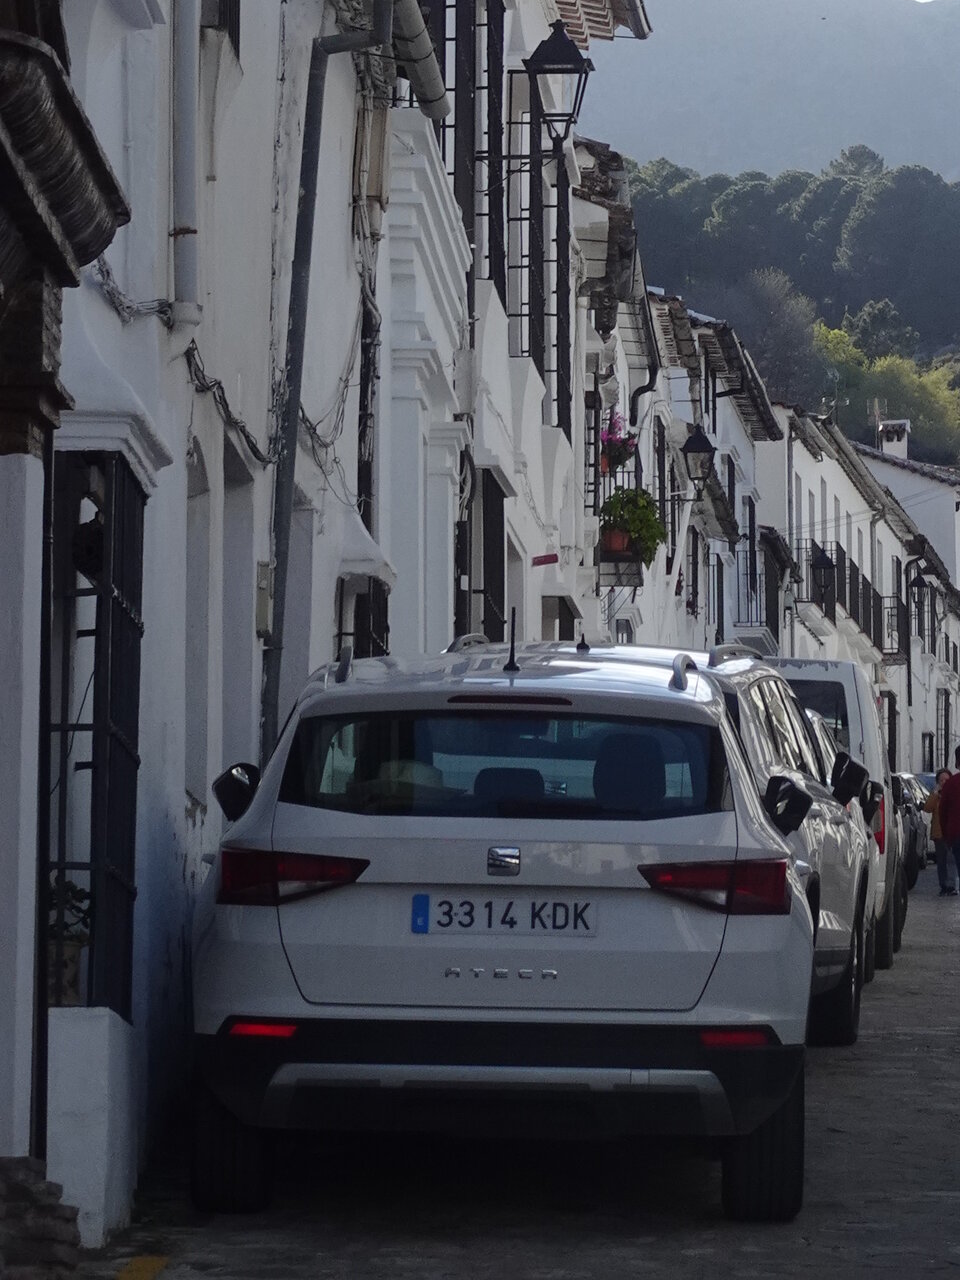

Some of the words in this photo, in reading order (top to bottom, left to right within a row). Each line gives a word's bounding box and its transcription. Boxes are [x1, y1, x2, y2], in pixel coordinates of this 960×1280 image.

[436, 900, 517, 929] 3314
[530, 902, 591, 930] KDK
[444, 967, 558, 980] ATECA
